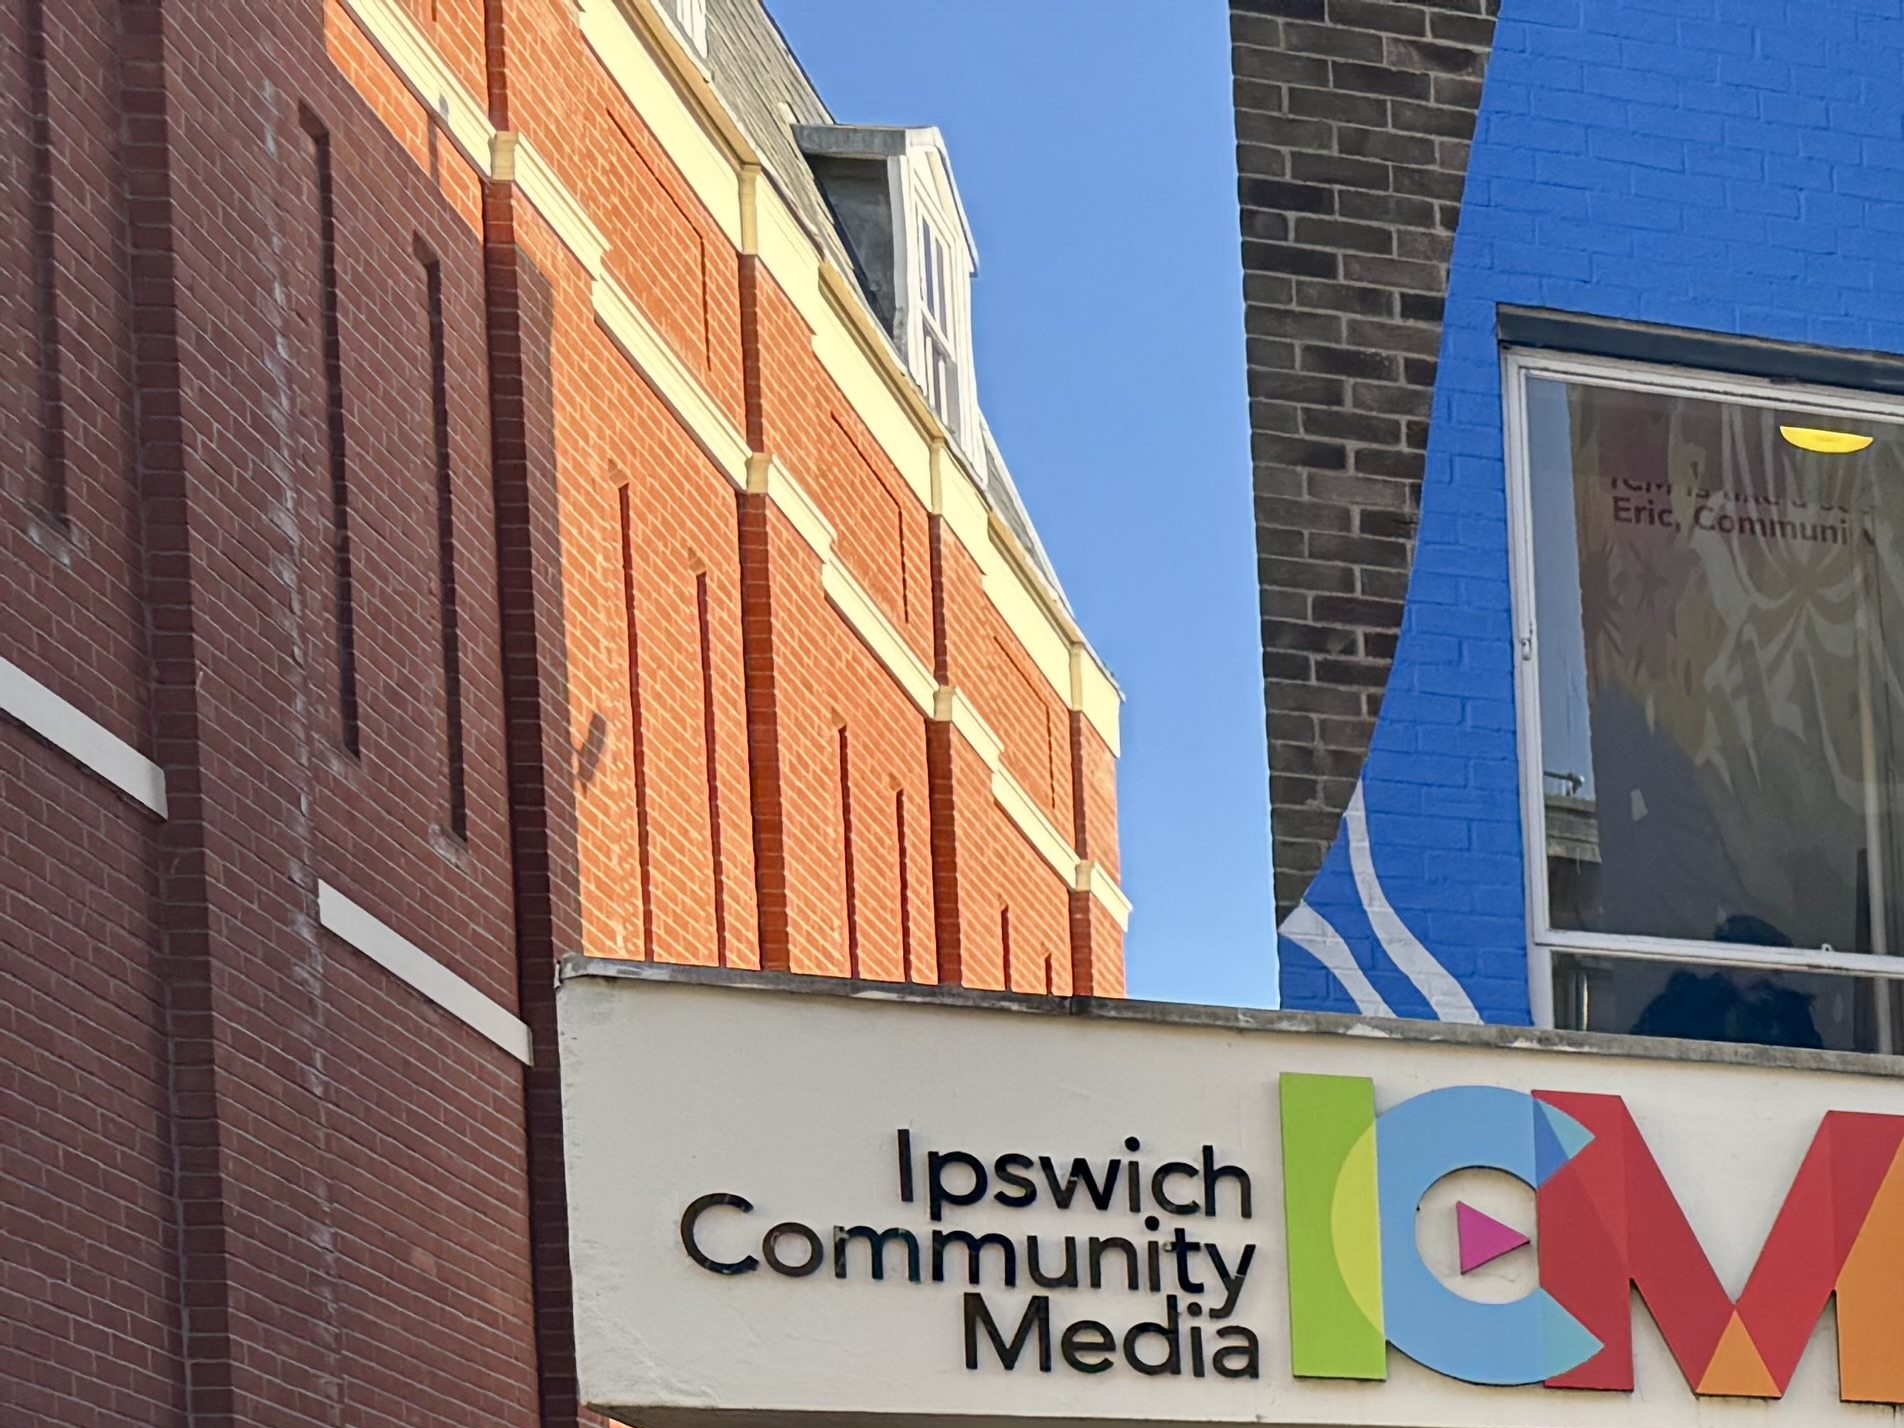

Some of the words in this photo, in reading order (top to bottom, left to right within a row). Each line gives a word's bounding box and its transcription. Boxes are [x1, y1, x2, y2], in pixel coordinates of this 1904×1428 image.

[897, 1128, 1252, 1222] Ipswich
[679, 1191, 1256, 1320] Community
[962, 1293, 1260, 1379] Media
